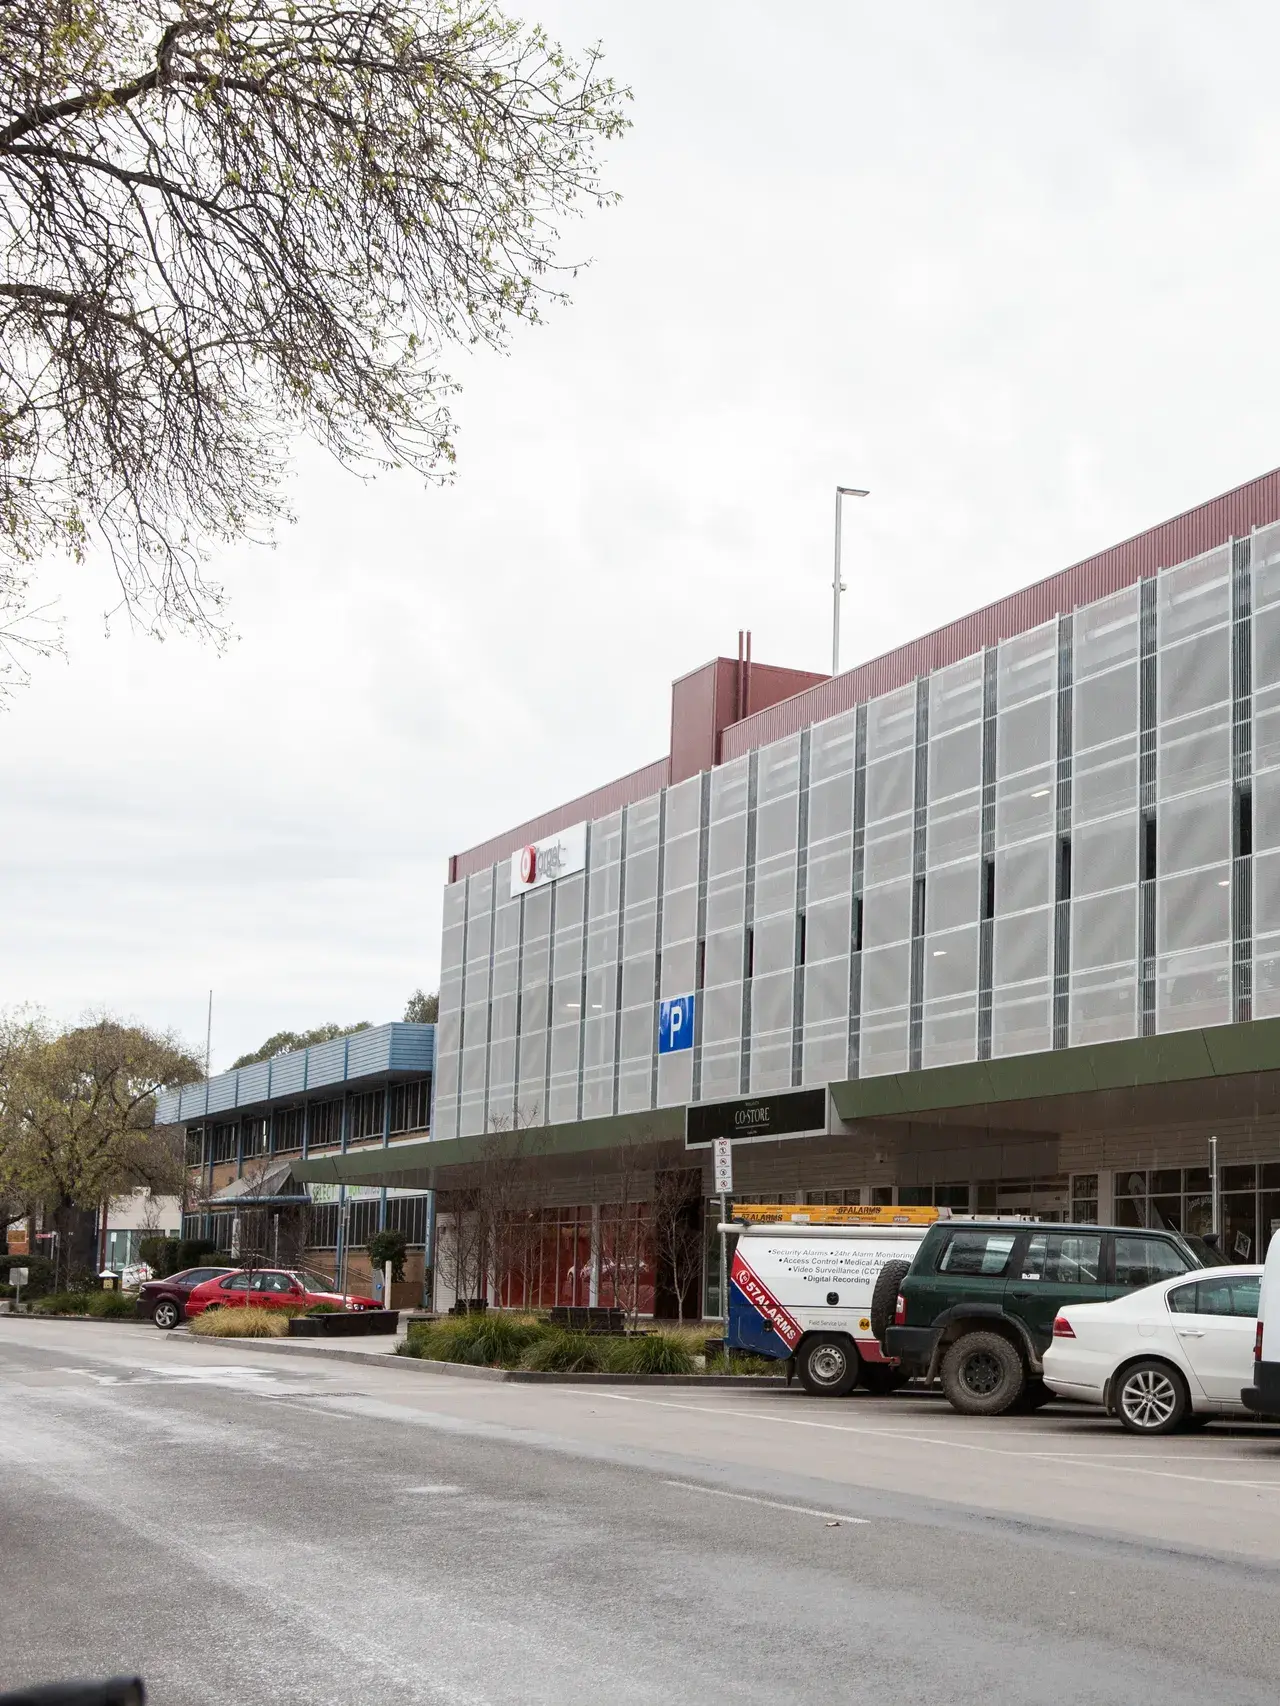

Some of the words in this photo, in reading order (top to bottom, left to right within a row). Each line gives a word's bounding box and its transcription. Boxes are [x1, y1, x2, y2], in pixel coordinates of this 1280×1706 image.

[670, 1005, 683, 1048] P
[771, 1248, 801, 1256] Security
[875, 1251, 915, 1259] Monitoring
[811, 1257, 838, 1265] Control
[845, 1258, 872, 1266] Medical
[807, 1275, 831, 1283] Digital
[832, 1275, 870, 1285] Recording
